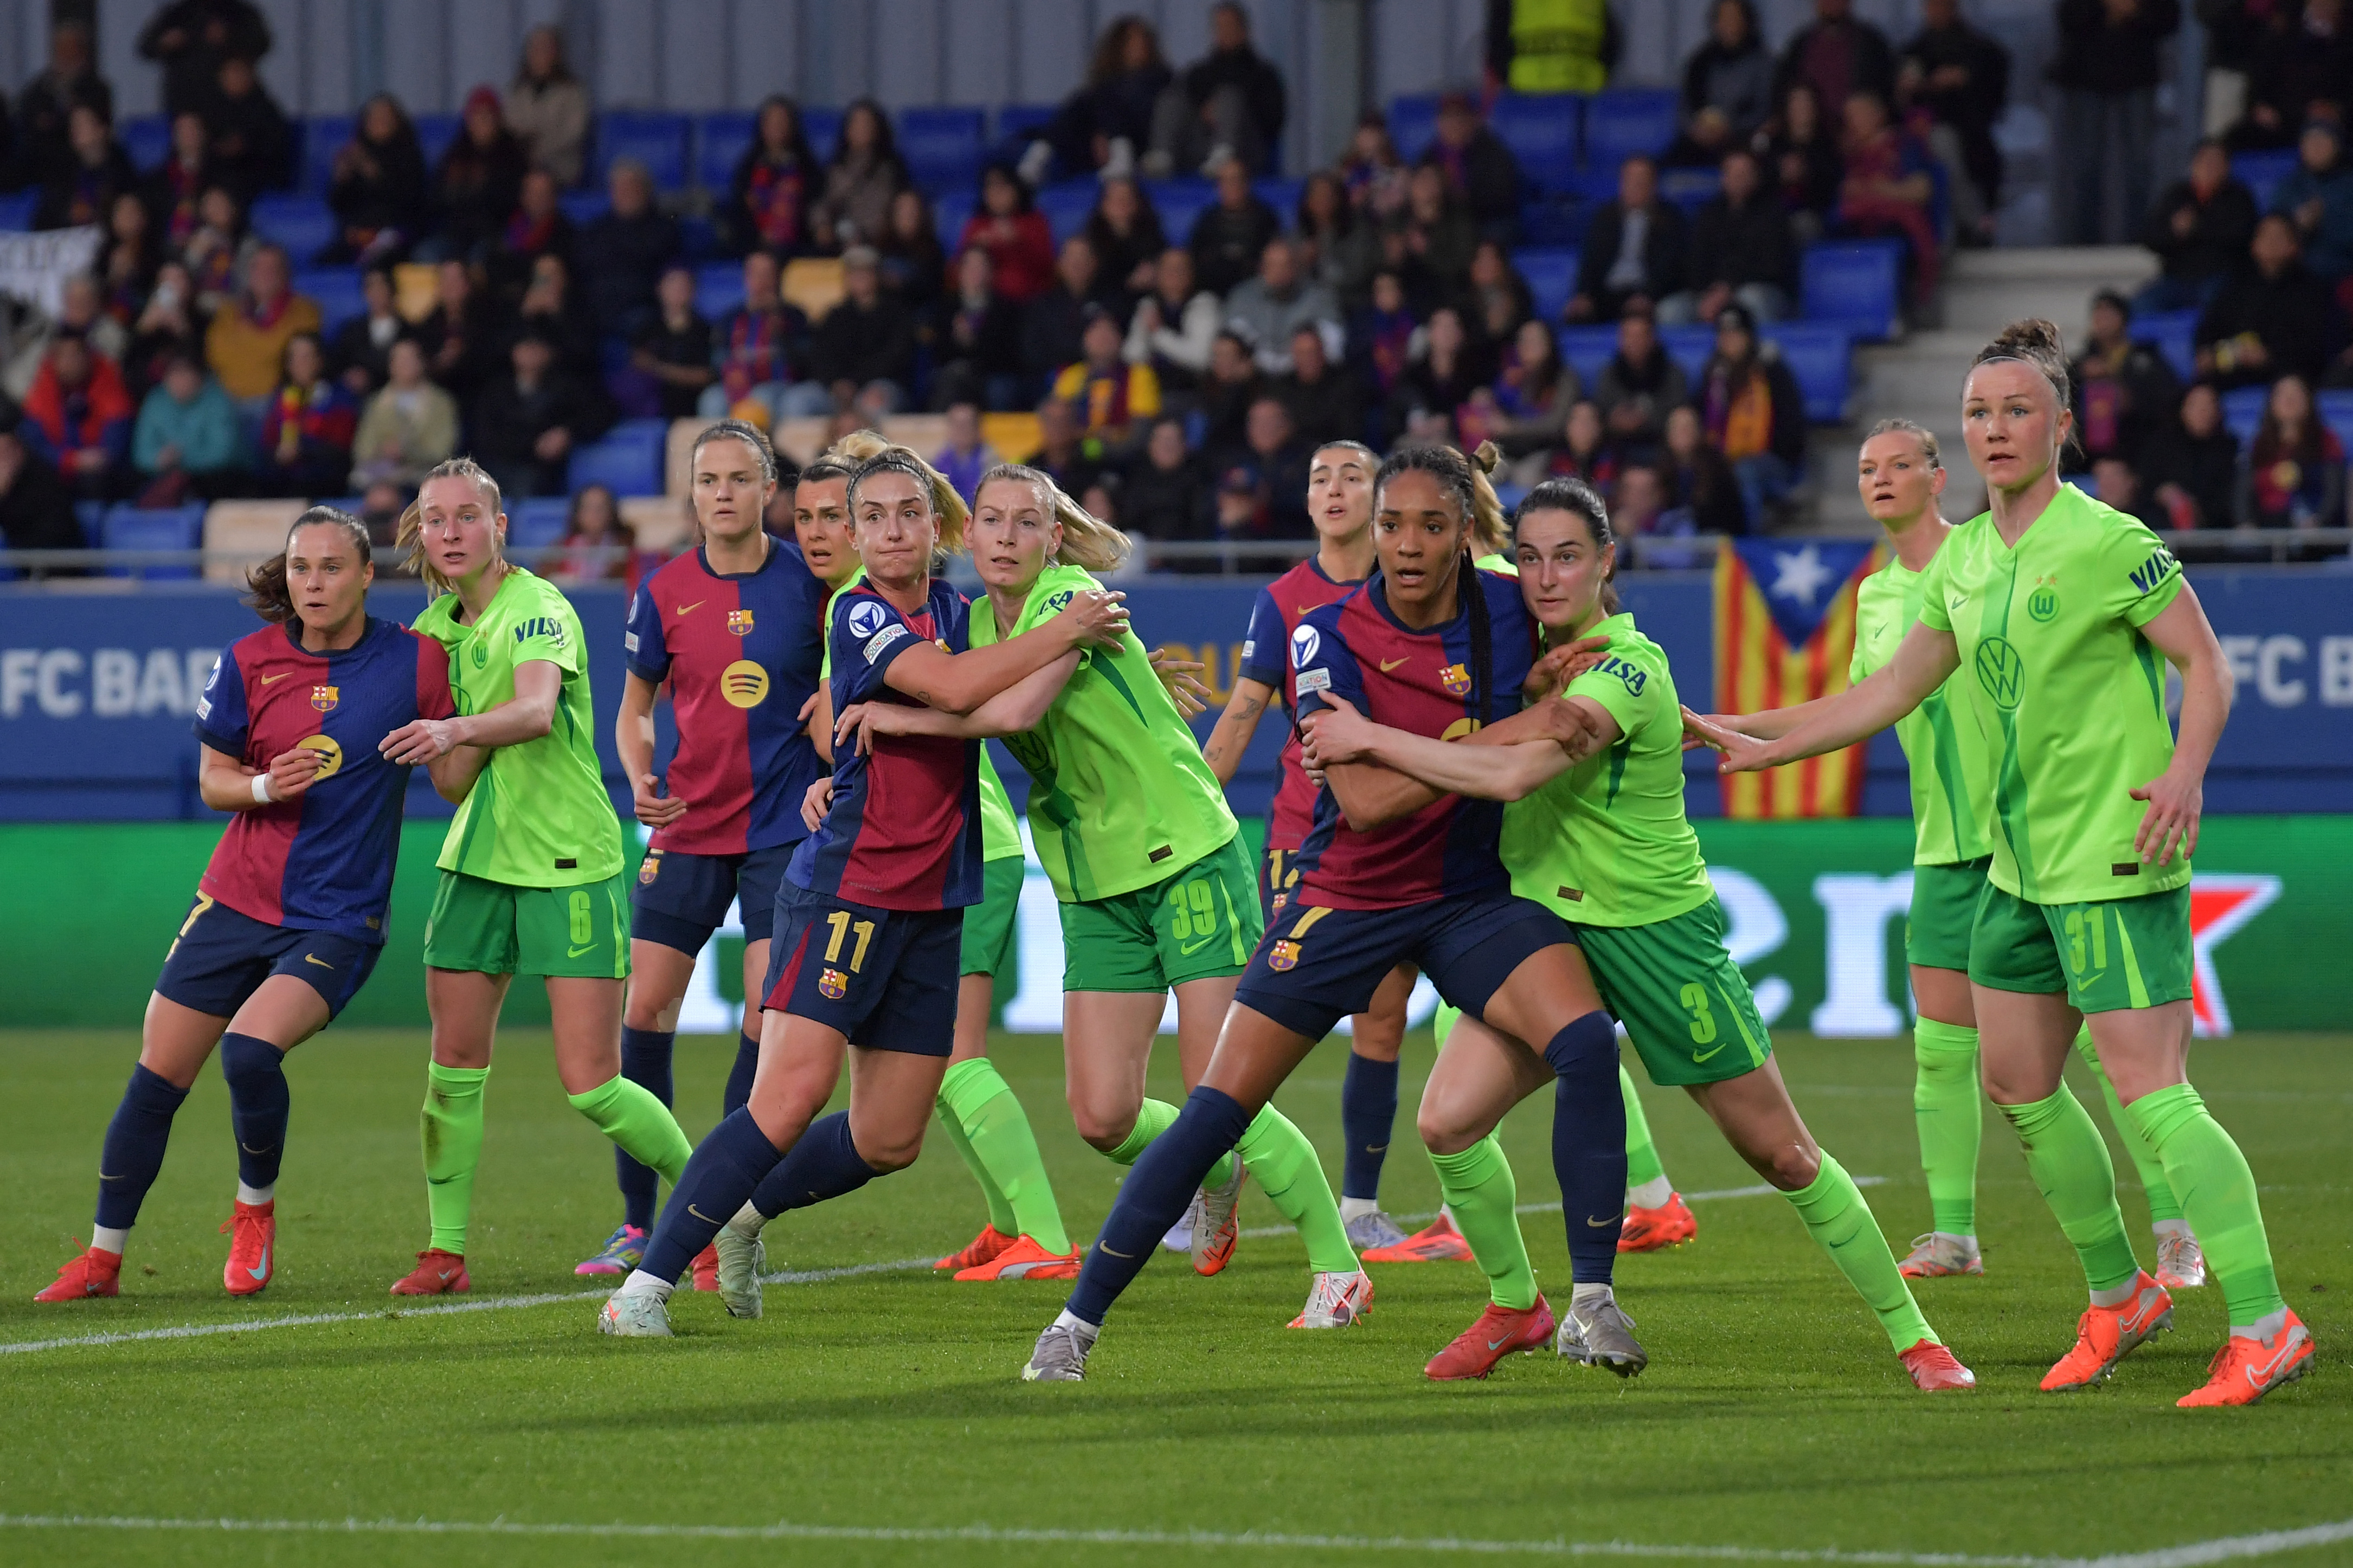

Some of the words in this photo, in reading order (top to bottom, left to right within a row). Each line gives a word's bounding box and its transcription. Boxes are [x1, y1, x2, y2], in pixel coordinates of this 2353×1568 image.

[3, 649, 79, 717] FC
[1581, 657, 1647, 696] ILSA
[569, 891, 592, 944] 6
[1169, 879, 1217, 939] 39
[2066, 906, 2106, 974] 31
[824, 911, 876, 974] 11
[1680, 982, 1716, 1044] 3
